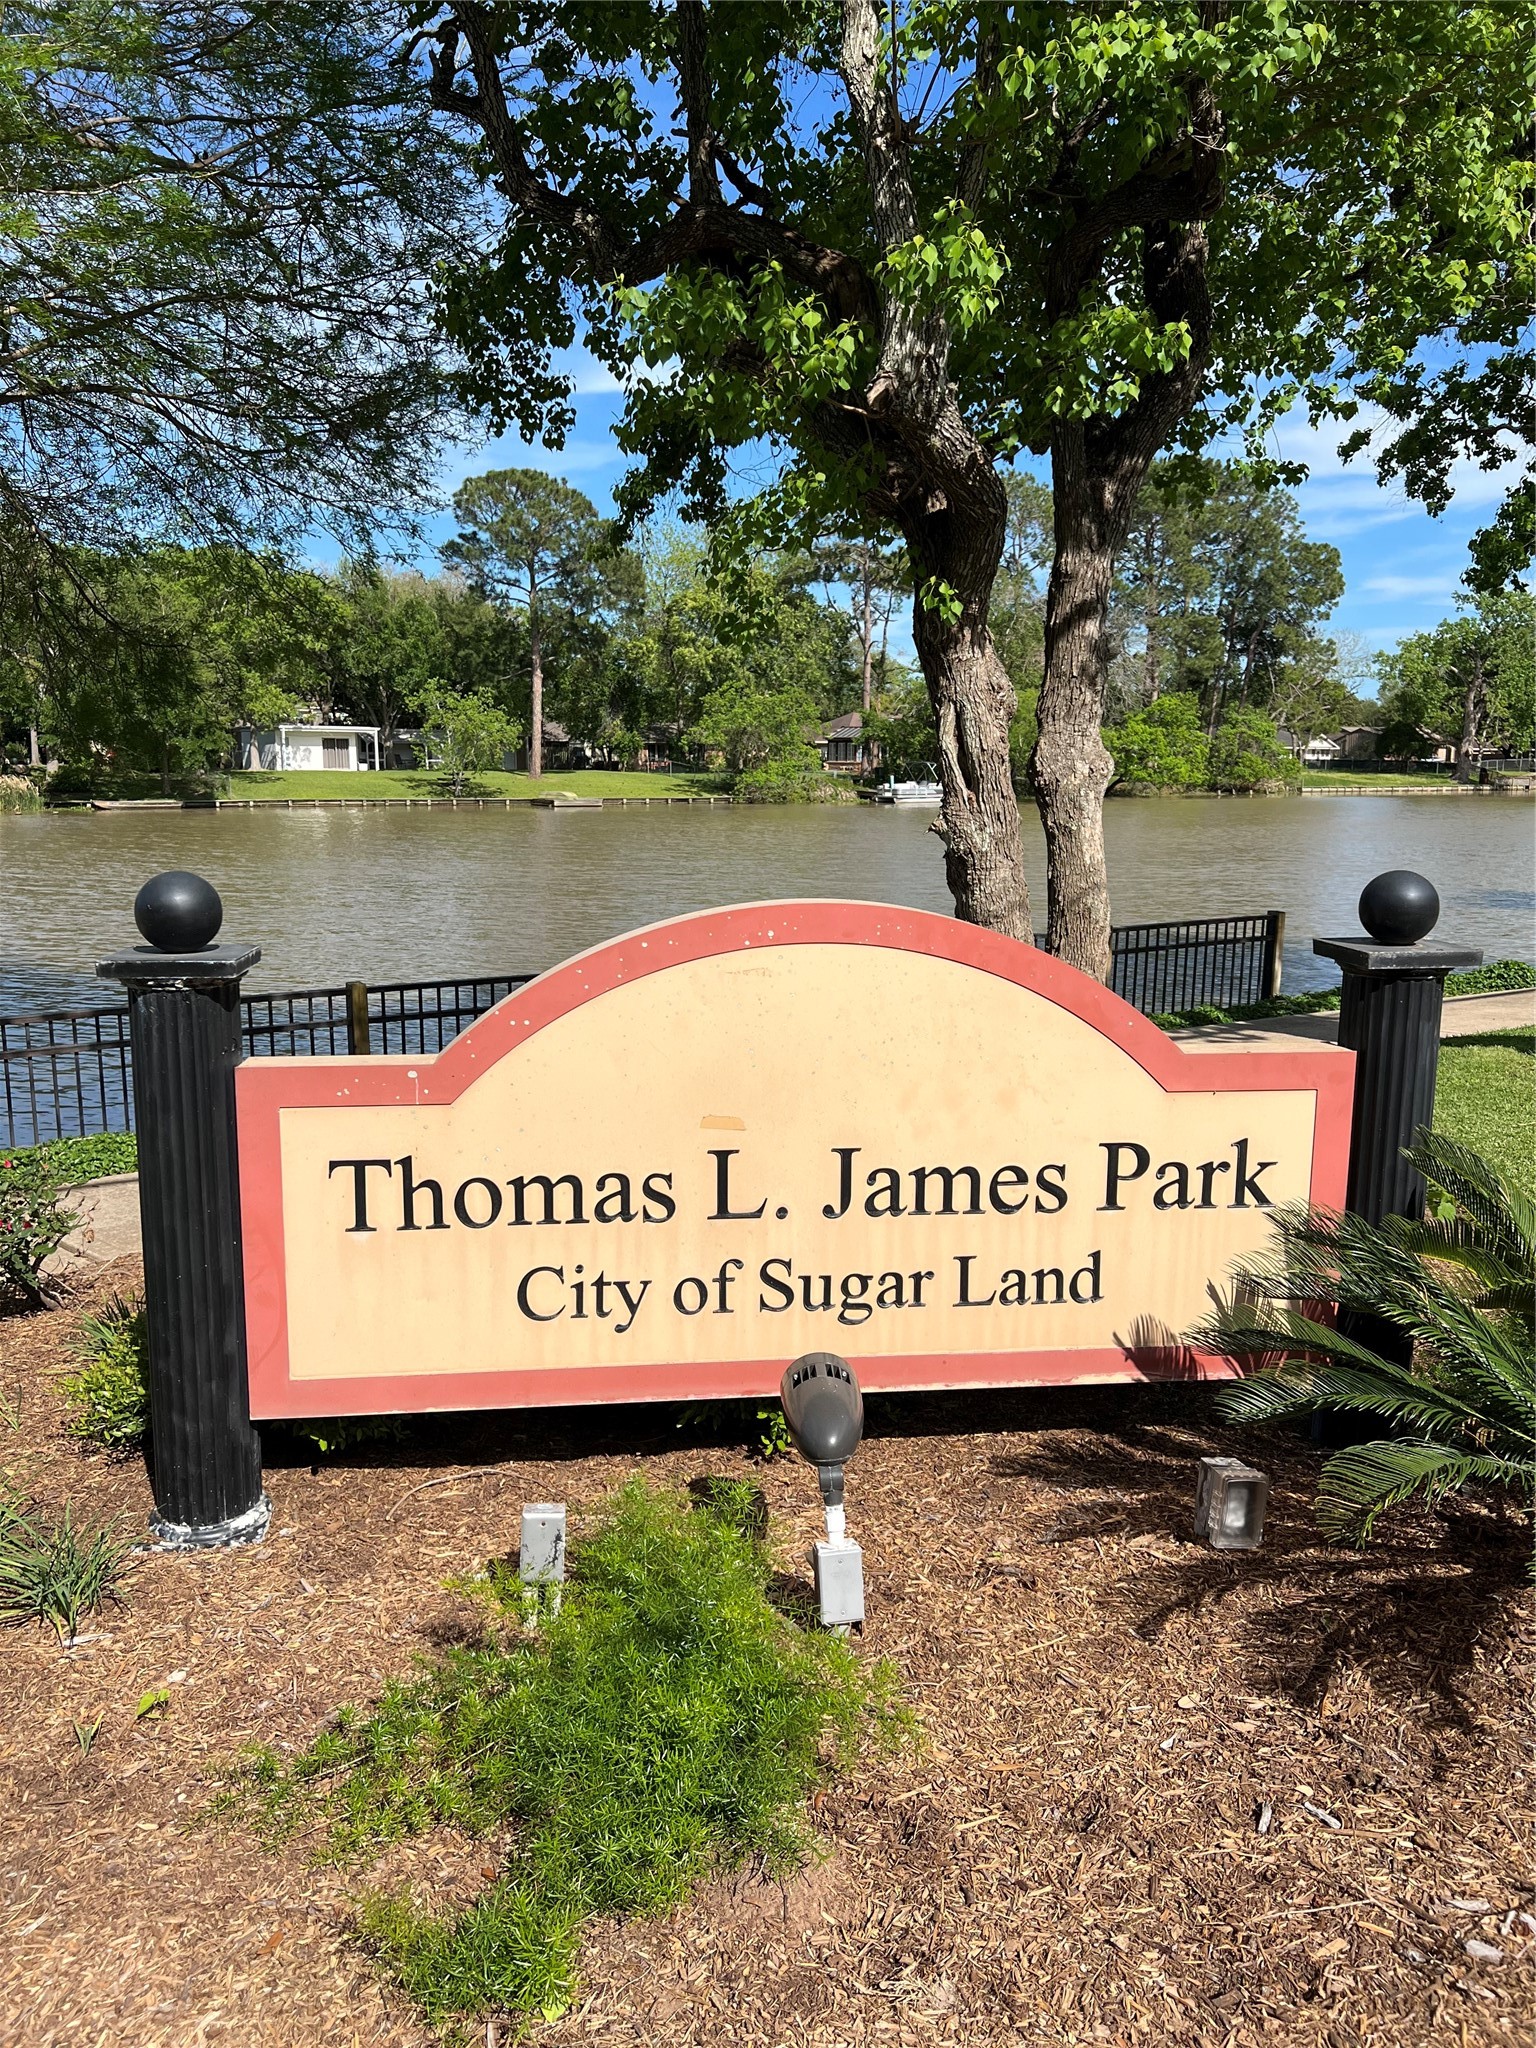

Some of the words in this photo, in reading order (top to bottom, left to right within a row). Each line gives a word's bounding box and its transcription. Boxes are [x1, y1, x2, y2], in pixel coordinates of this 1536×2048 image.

[328, 1156, 676, 1233] Thomas
[706, 1149, 789, 1221] L.
[822, 1147, 1068, 1220] James
[1096, 1137, 1278, 1211] Park
[517, 1264, 653, 1334] City
[673, 1258, 744, 1316] of
[759, 1256, 935, 1326] Sugar
[952, 1249, 1104, 1308] Land
